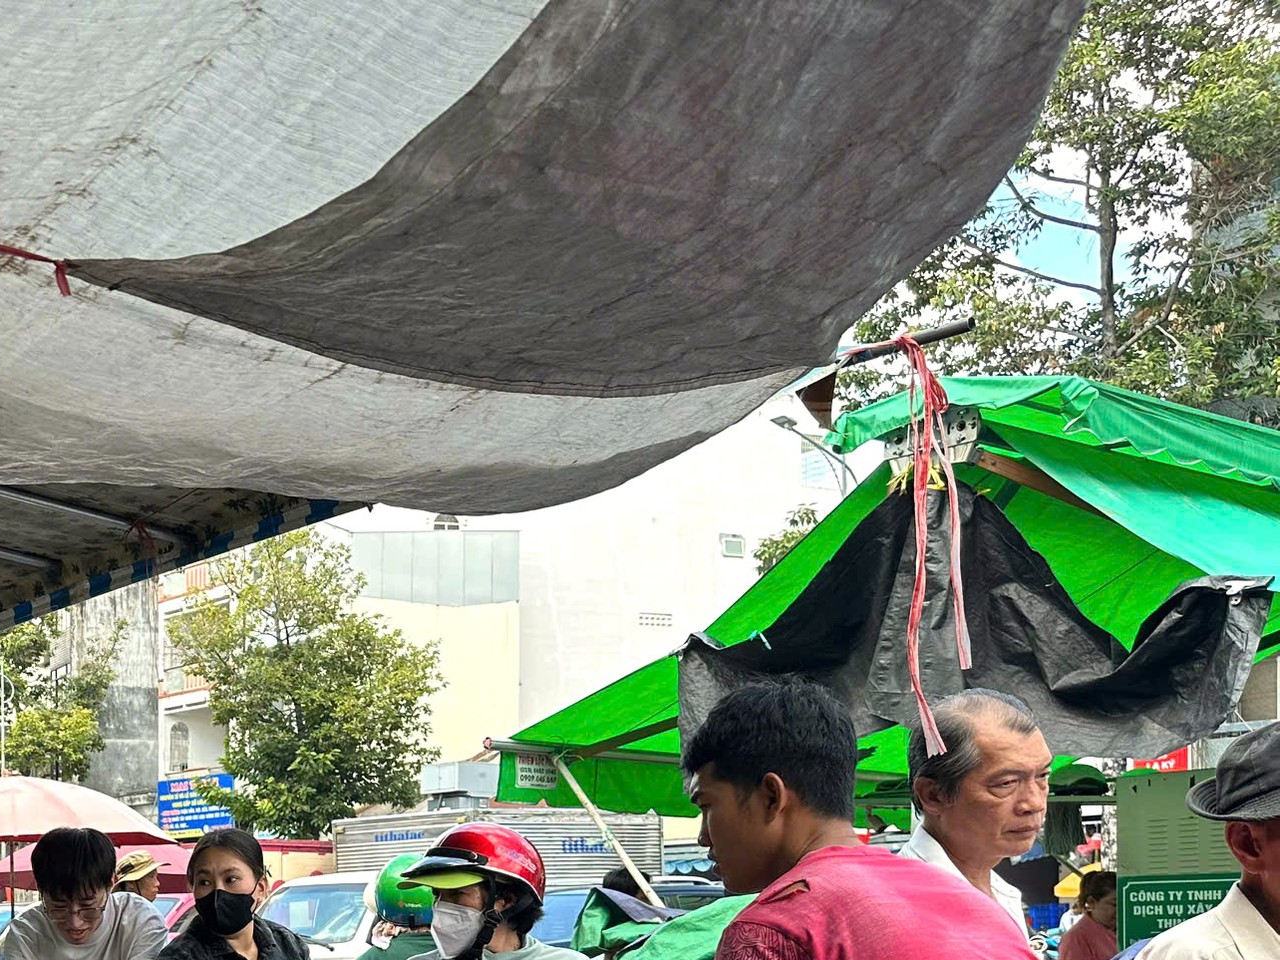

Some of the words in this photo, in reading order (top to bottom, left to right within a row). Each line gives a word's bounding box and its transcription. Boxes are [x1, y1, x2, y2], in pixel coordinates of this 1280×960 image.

[1129, 889, 1165, 902] CÔNG
[1169, 890, 1183, 901] TY
[1187, 889, 1222, 901] TNHH
[1133, 904, 1163, 917] DỊCH
[1167, 904, 1183, 917] VỤ
